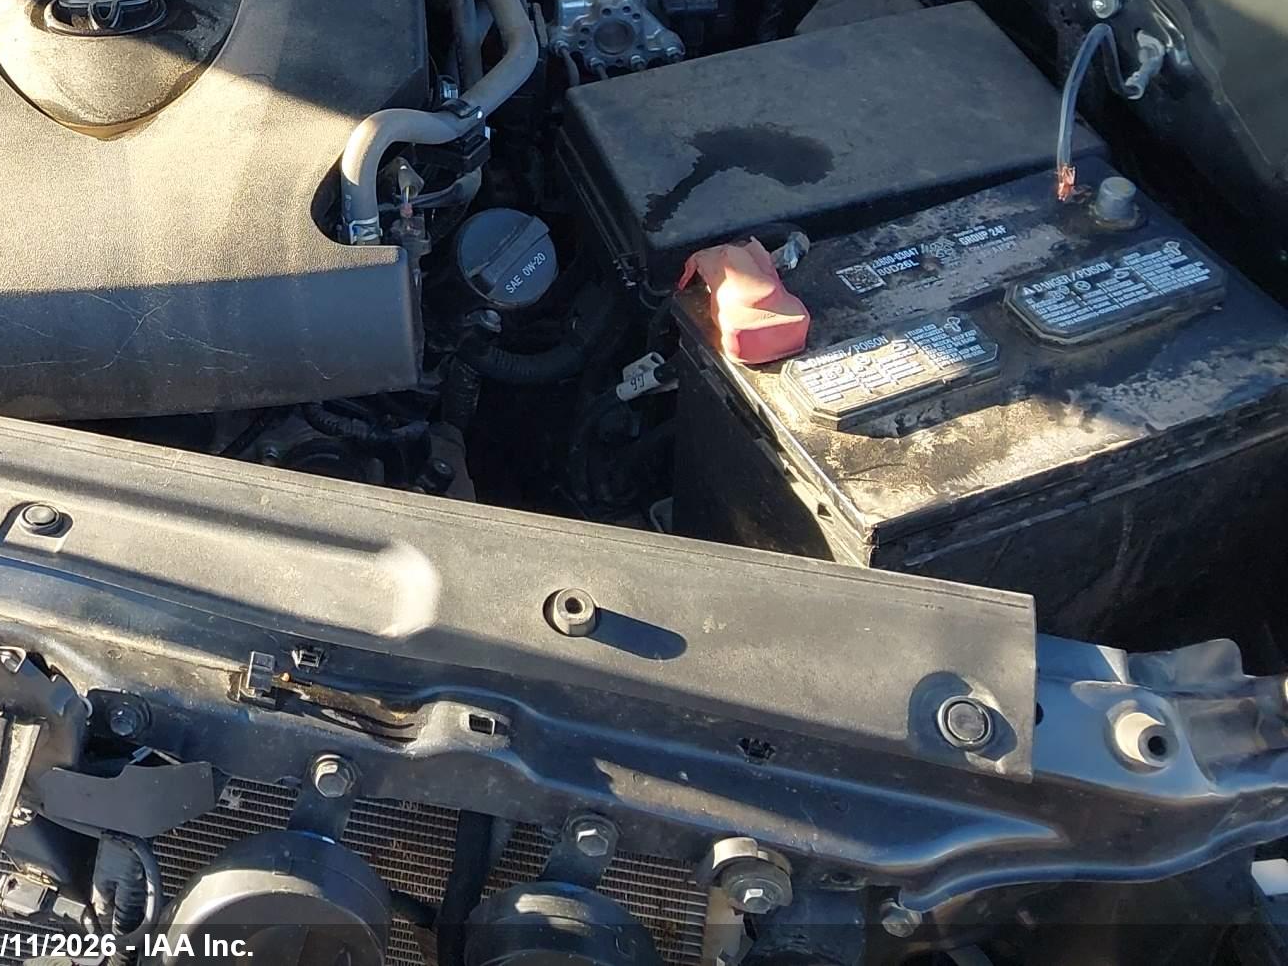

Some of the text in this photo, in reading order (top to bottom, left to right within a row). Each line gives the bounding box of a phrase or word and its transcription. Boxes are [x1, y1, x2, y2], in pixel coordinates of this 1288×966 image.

[958, 230, 989, 246] GROUP
[987, 224, 1008, 237] 24F
[505, 252, 546, 294] SAE 0W-20
